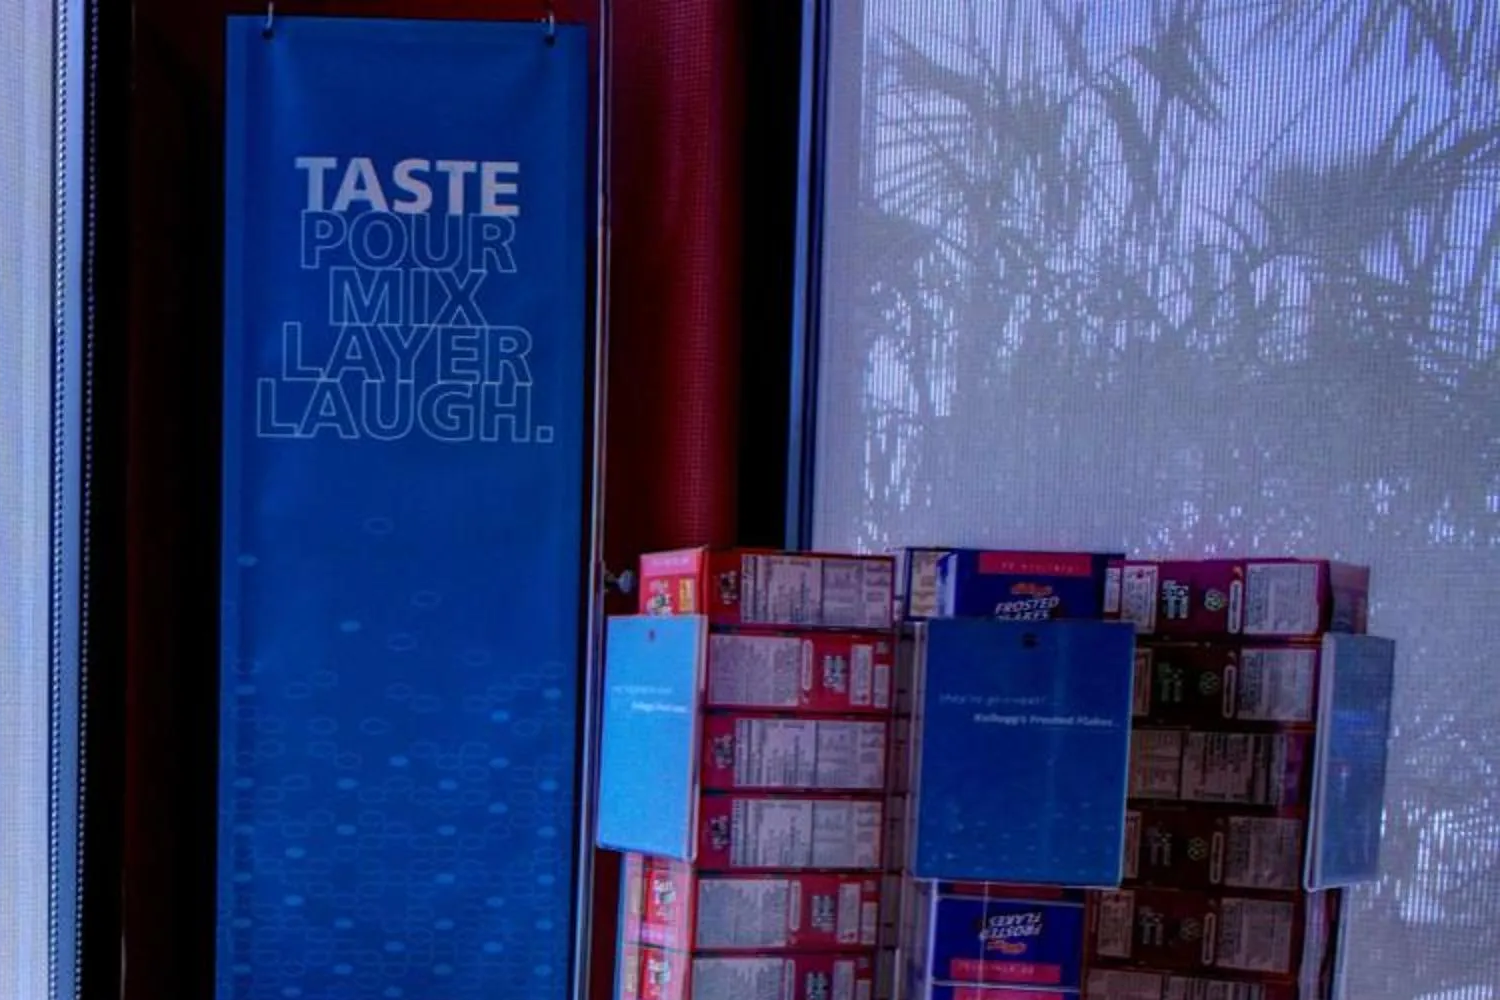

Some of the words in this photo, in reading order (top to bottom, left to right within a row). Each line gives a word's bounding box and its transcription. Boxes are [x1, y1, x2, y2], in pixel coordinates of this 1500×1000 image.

[295, 157, 520, 216] TASTE
[300, 210, 517, 273] POUR
[329, 266, 488, 327] MIX
[282, 321, 533, 385] LAYER
[257, 378, 554, 443] LAUGH.
[995, 596, 1060, 613] FROSTED
